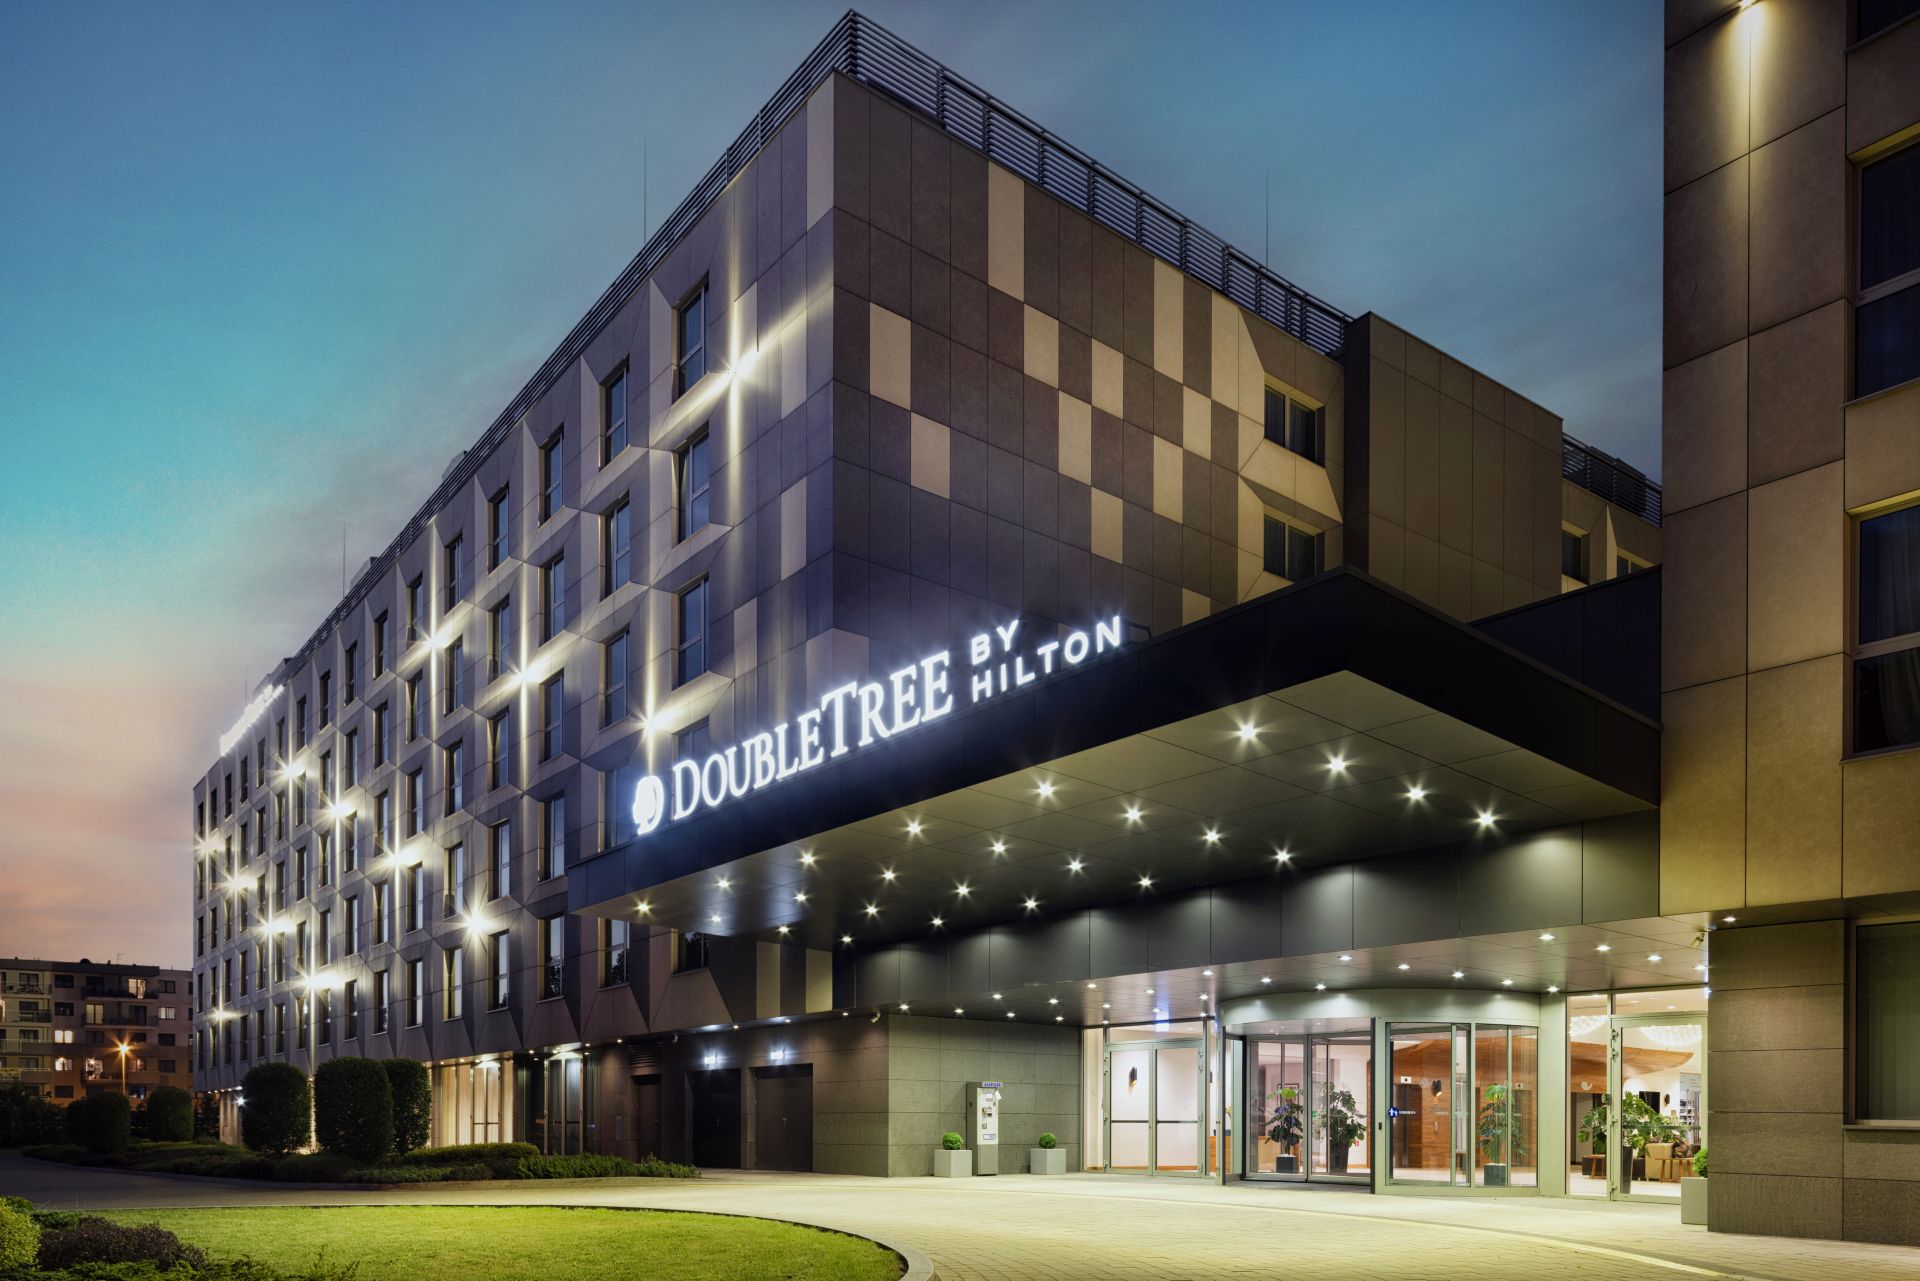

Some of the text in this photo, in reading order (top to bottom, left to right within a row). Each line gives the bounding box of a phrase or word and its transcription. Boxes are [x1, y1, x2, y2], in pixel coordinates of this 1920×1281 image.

[971, 619, 1018, 665] BY
[972, 616, 1120, 702] HILTON
[672, 650, 952, 820] DOUBLETREE
